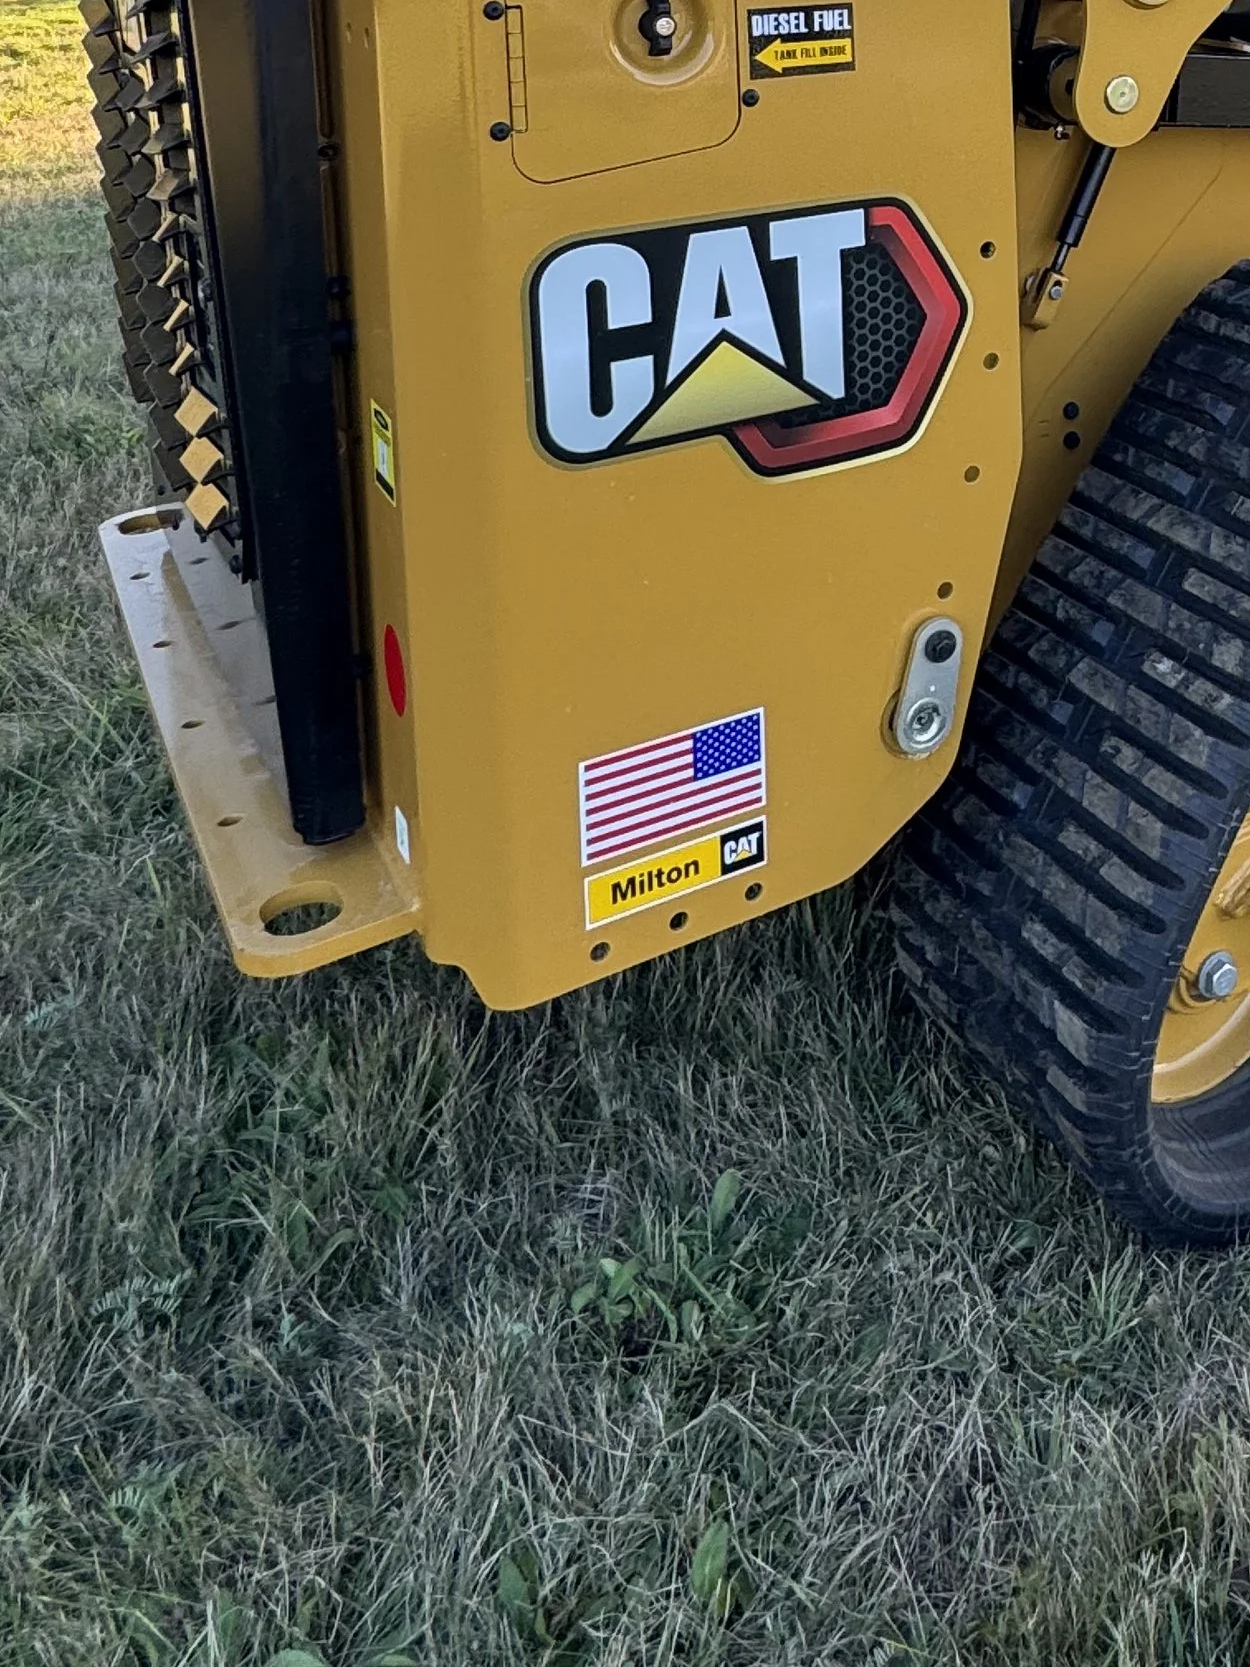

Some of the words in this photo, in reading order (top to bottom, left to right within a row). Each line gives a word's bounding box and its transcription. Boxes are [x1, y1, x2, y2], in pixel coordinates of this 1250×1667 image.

[751, 12, 809, 37] DIESEL
[813, 9, 852, 32] FUEL
[800, 47, 817, 59] FILL
[539, 208, 866, 454] CAT
[611, 859, 700, 905] Milton
[723, 831, 763, 866] CAT
